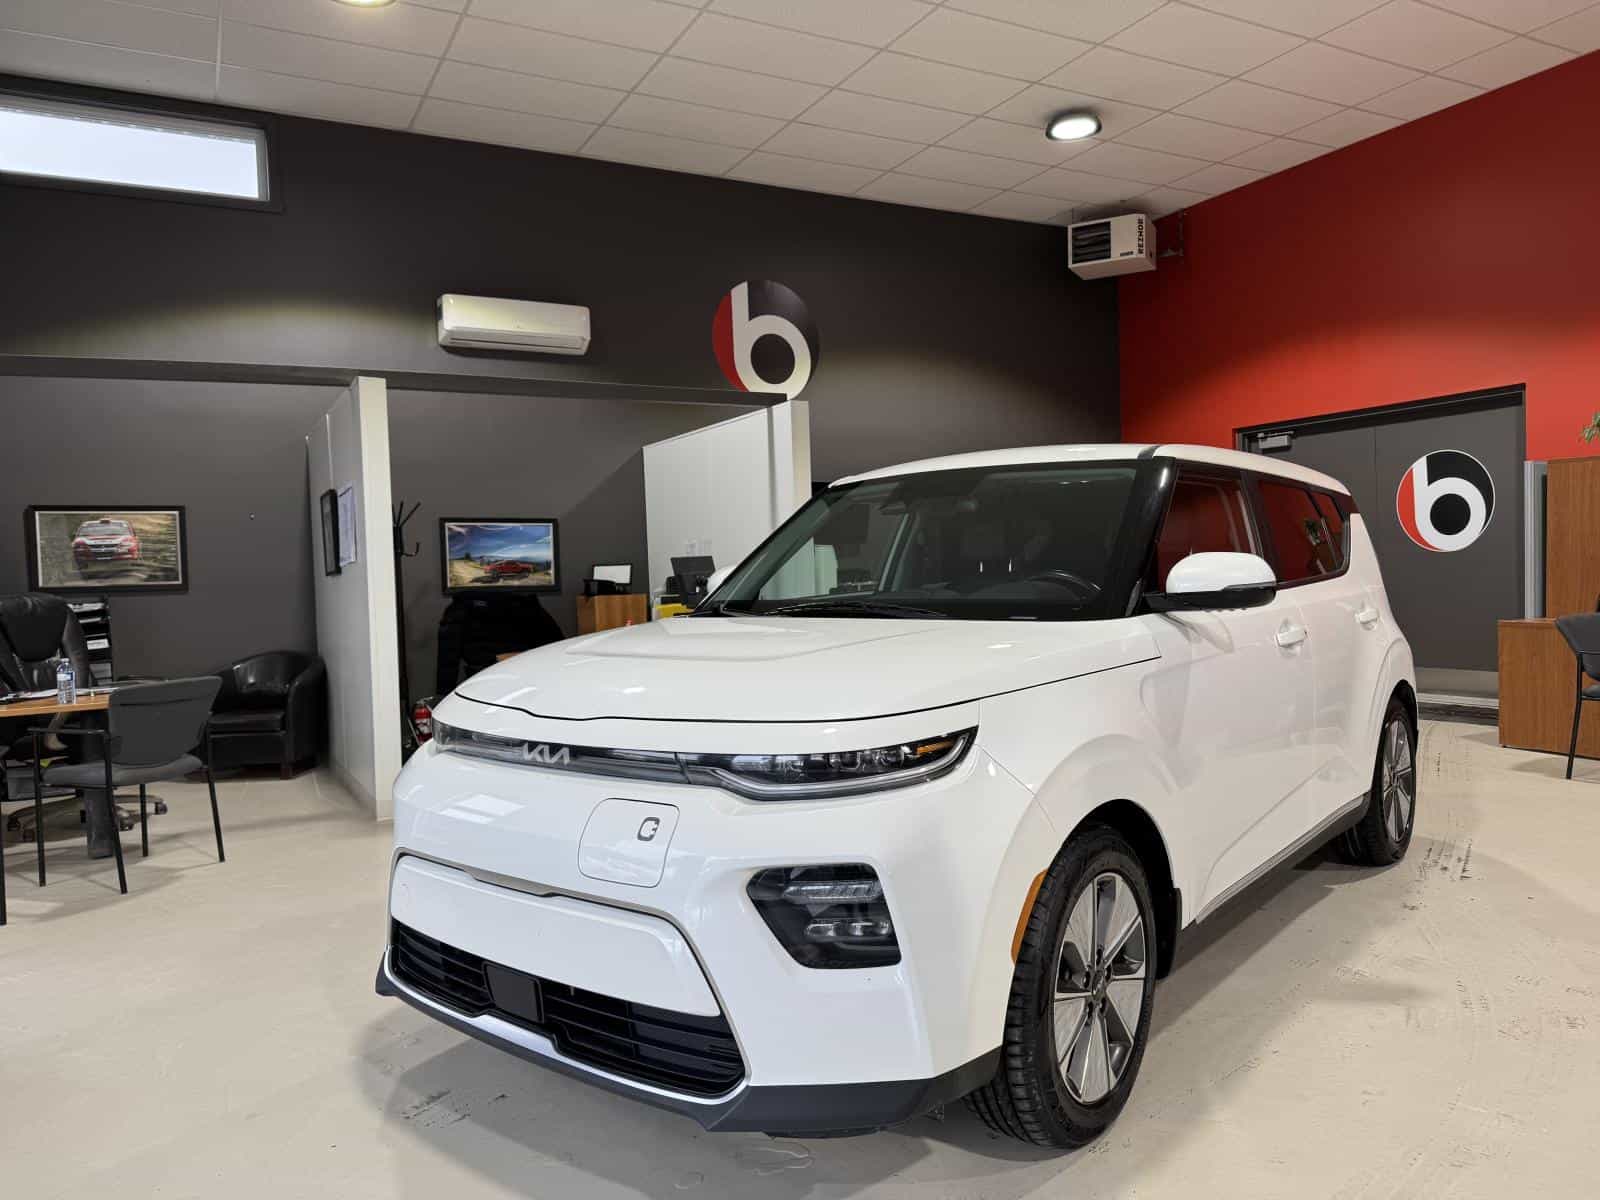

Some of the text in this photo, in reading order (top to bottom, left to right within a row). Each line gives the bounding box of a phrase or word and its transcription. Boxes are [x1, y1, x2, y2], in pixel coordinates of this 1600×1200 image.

[731, 281, 811, 400] b
[1413, 457, 1487, 552] b
[523, 742, 570, 765] KIA
